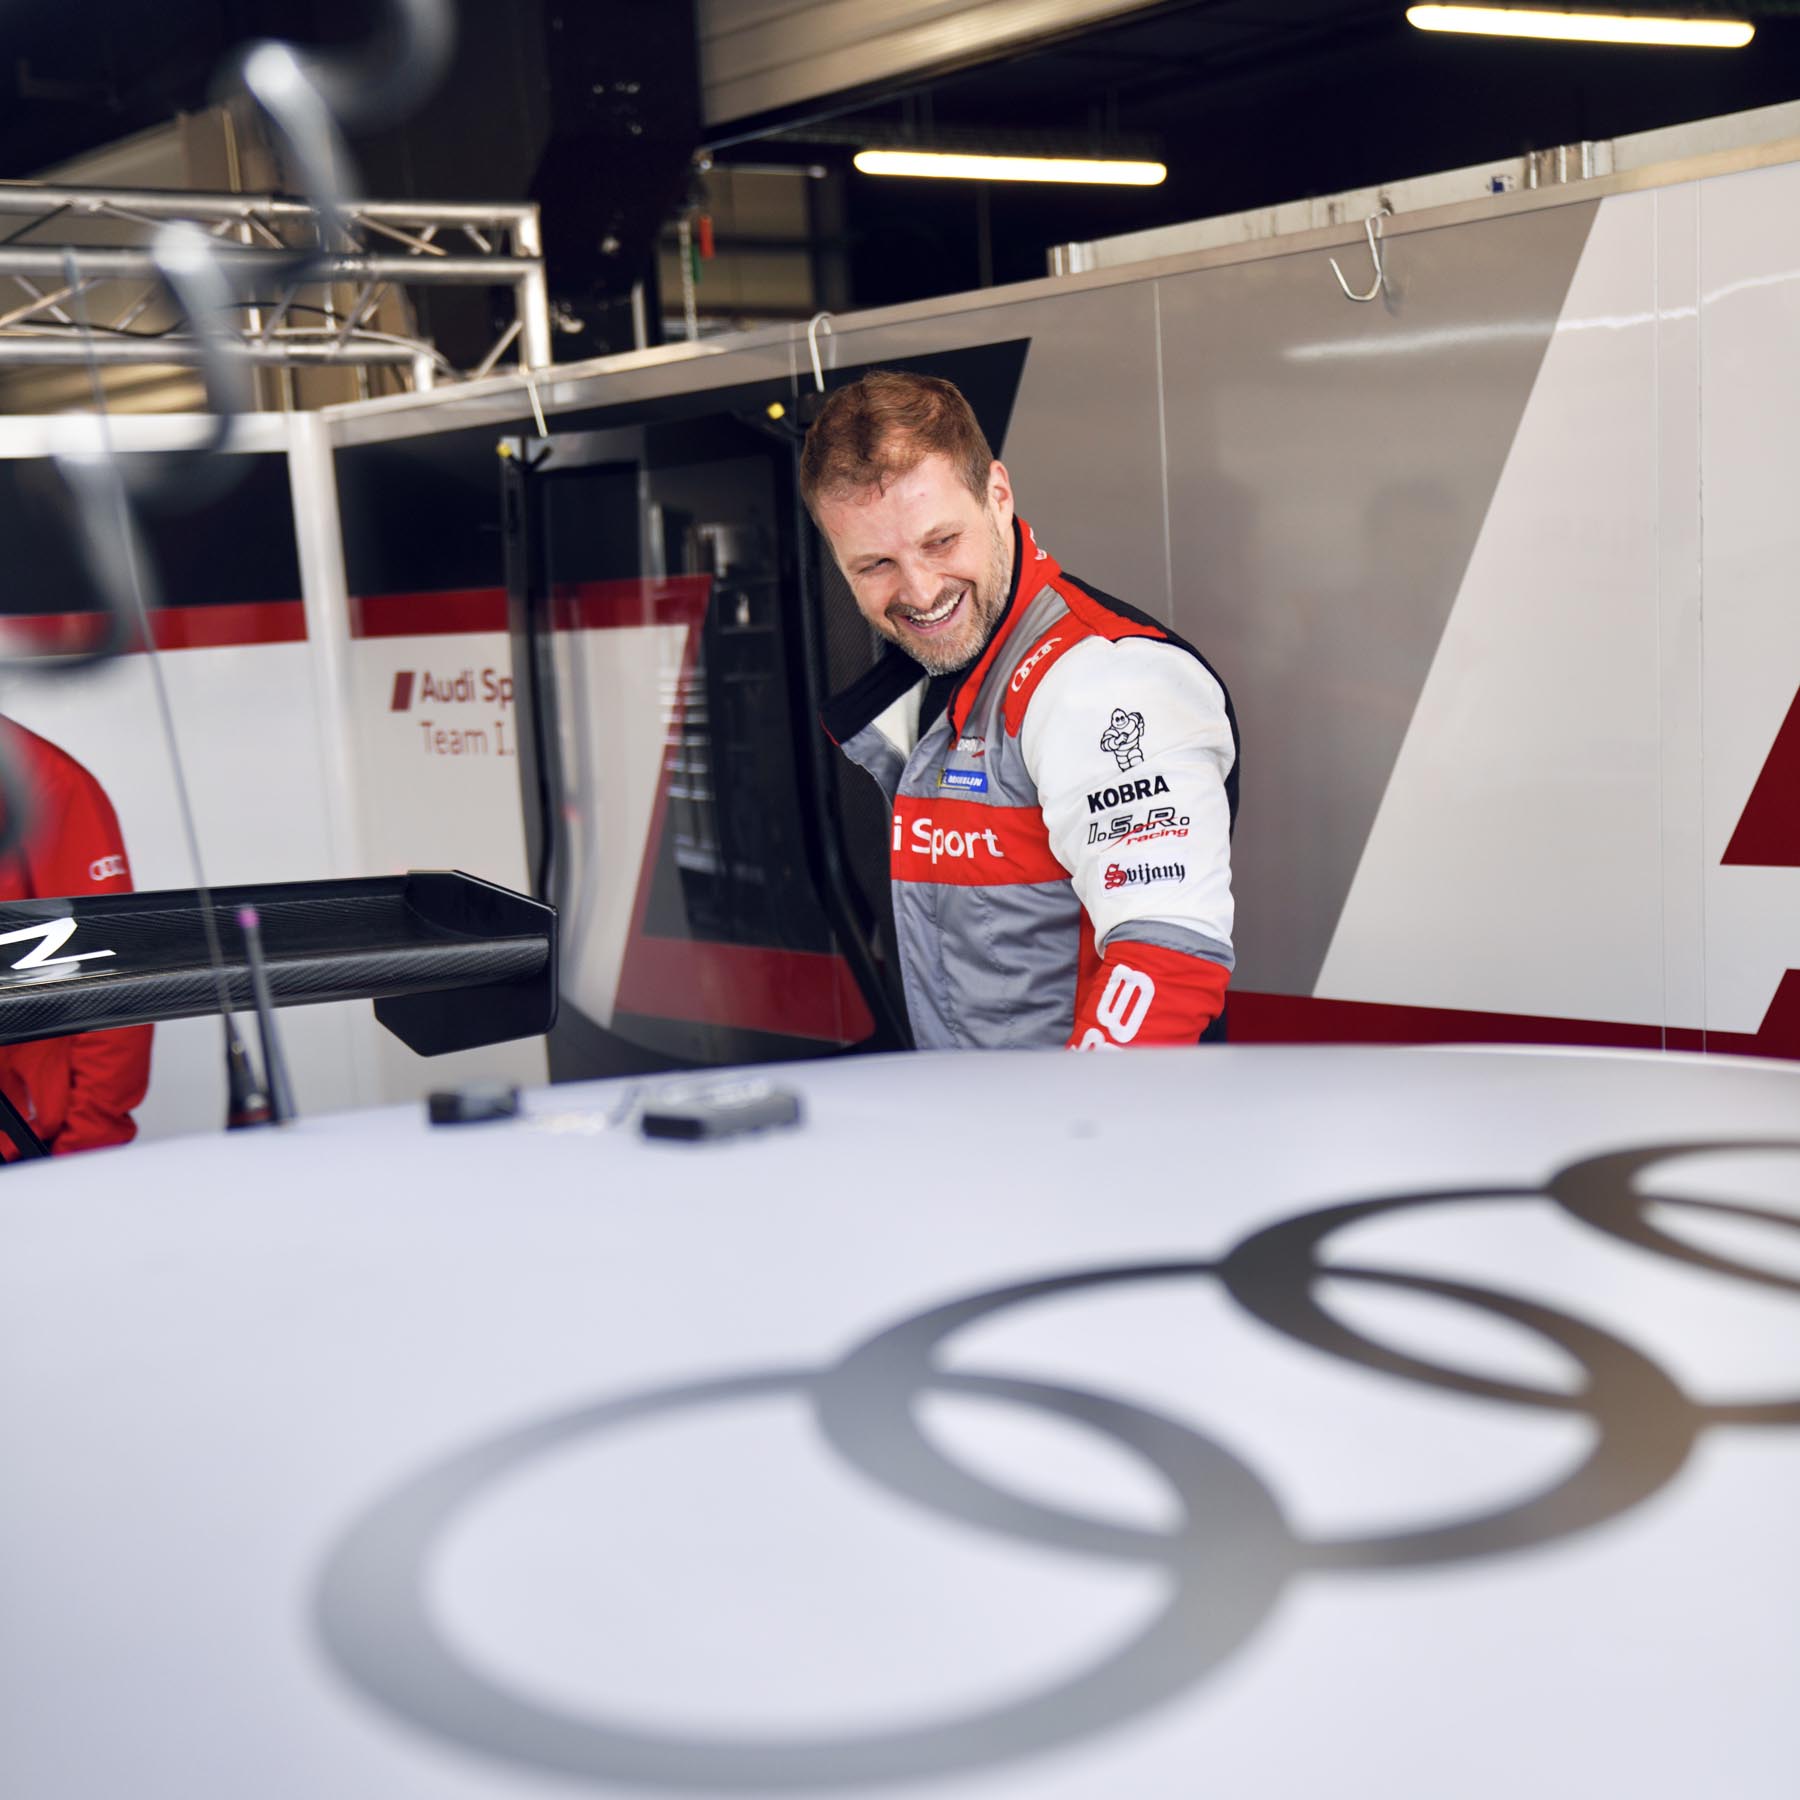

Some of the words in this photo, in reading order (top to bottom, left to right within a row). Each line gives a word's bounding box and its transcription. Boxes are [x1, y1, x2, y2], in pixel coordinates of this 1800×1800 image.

[420, 669, 476, 703] Audi
[481, 667, 513, 711] Sp
[419, 719, 488, 755] Team
[1087, 775, 1171, 814] KOBRA
[911, 817, 1005, 865] Sport
[1126, 827, 1190, 846] racing
[1104, 862, 1186, 890] Svijany
